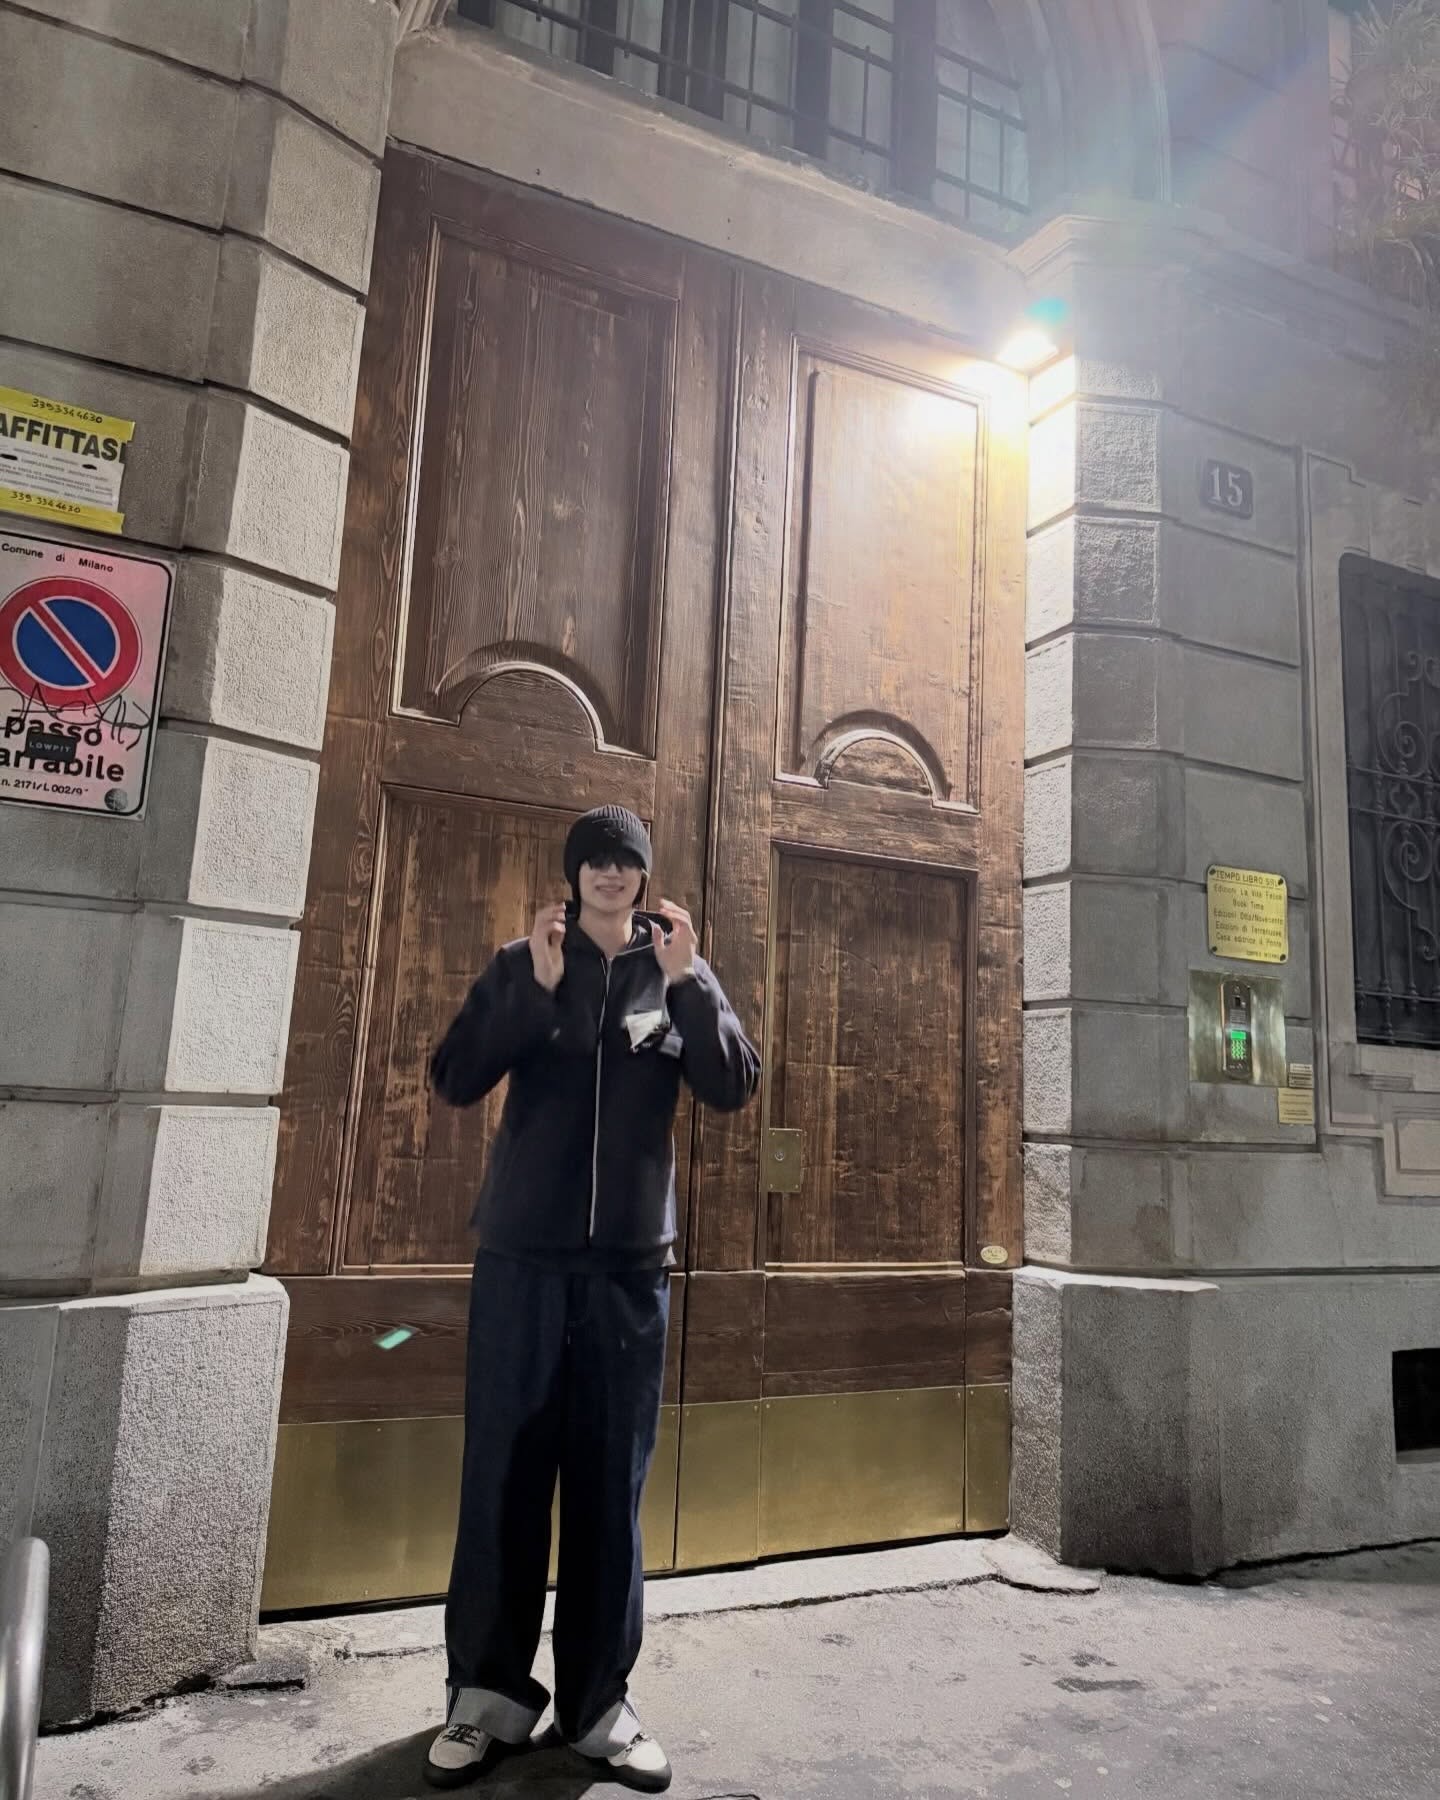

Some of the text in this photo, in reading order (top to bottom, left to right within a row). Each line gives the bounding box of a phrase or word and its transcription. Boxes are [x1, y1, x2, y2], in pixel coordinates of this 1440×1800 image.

[1207, 465, 1243, 507] 15
[1, 542, 114, 573] Comune di Milano
[1216, 870, 1279, 888] TEMPO LIBRO SRL
[1214, 883, 1237, 895] Edizioni
[1214, 907, 1237, 919] Edizioni
[1251, 900, 1264, 911] Time
